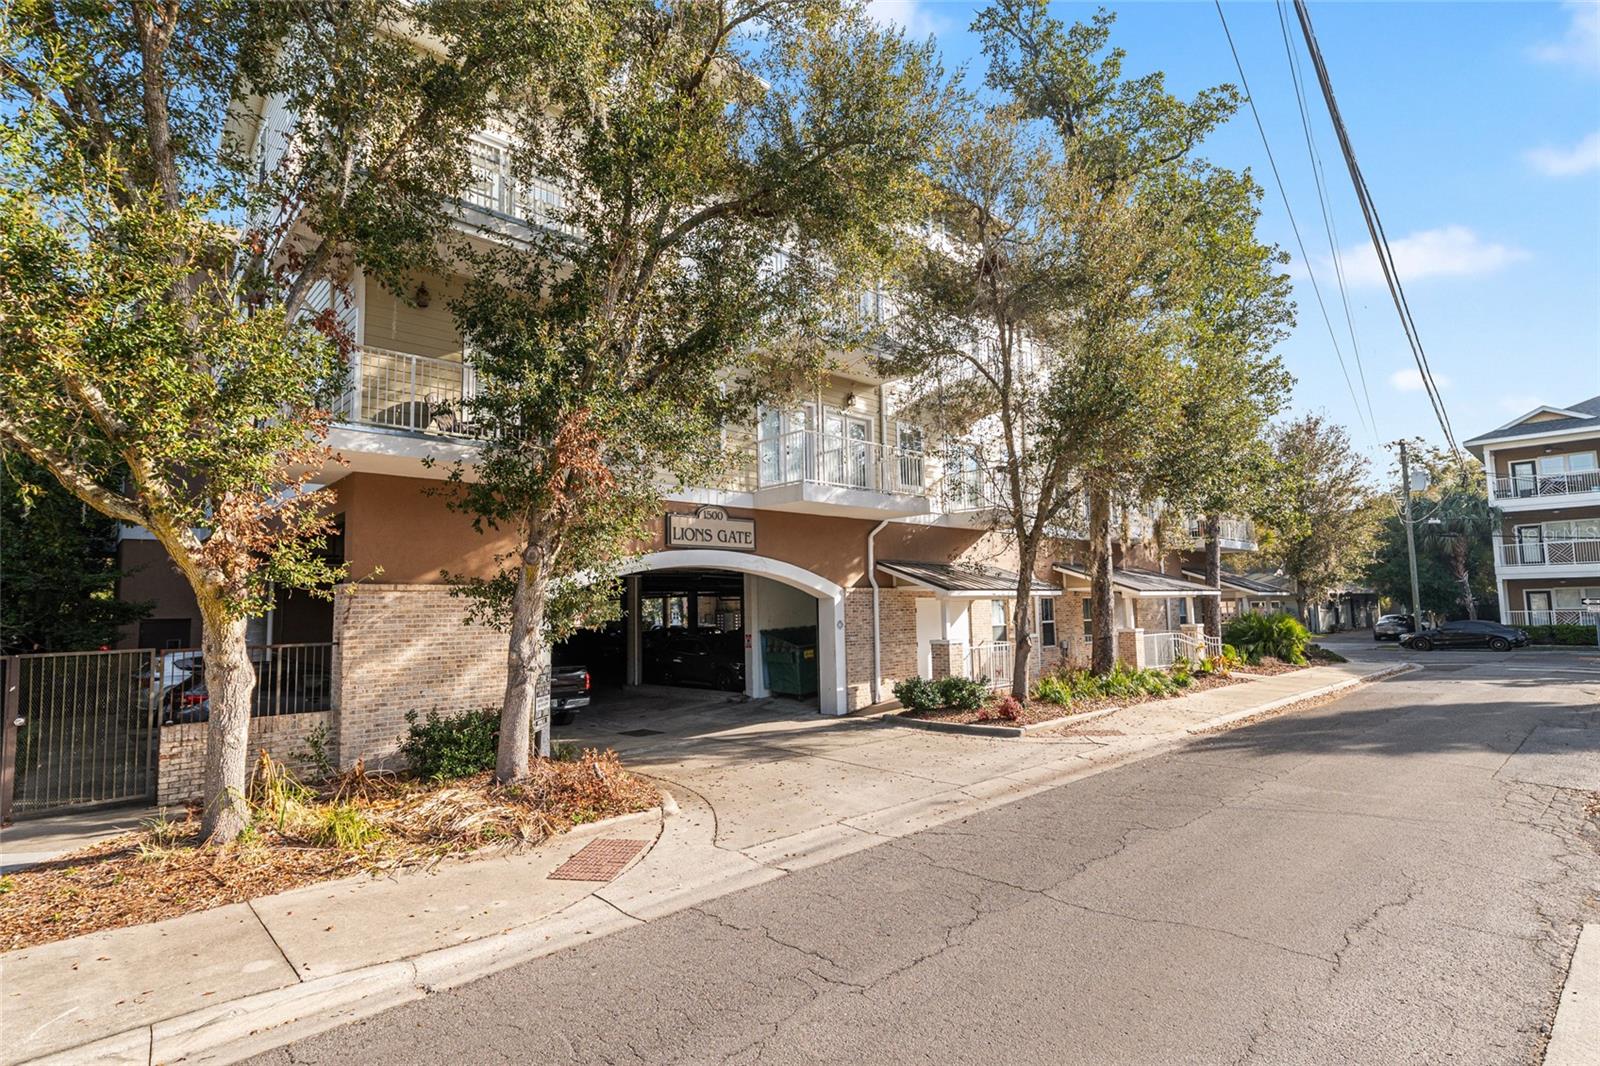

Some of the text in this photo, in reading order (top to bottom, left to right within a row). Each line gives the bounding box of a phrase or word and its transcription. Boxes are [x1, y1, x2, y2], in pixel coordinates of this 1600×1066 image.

[703, 510, 723, 521] 1500
[672, 526, 753, 545] LIONS GATE
